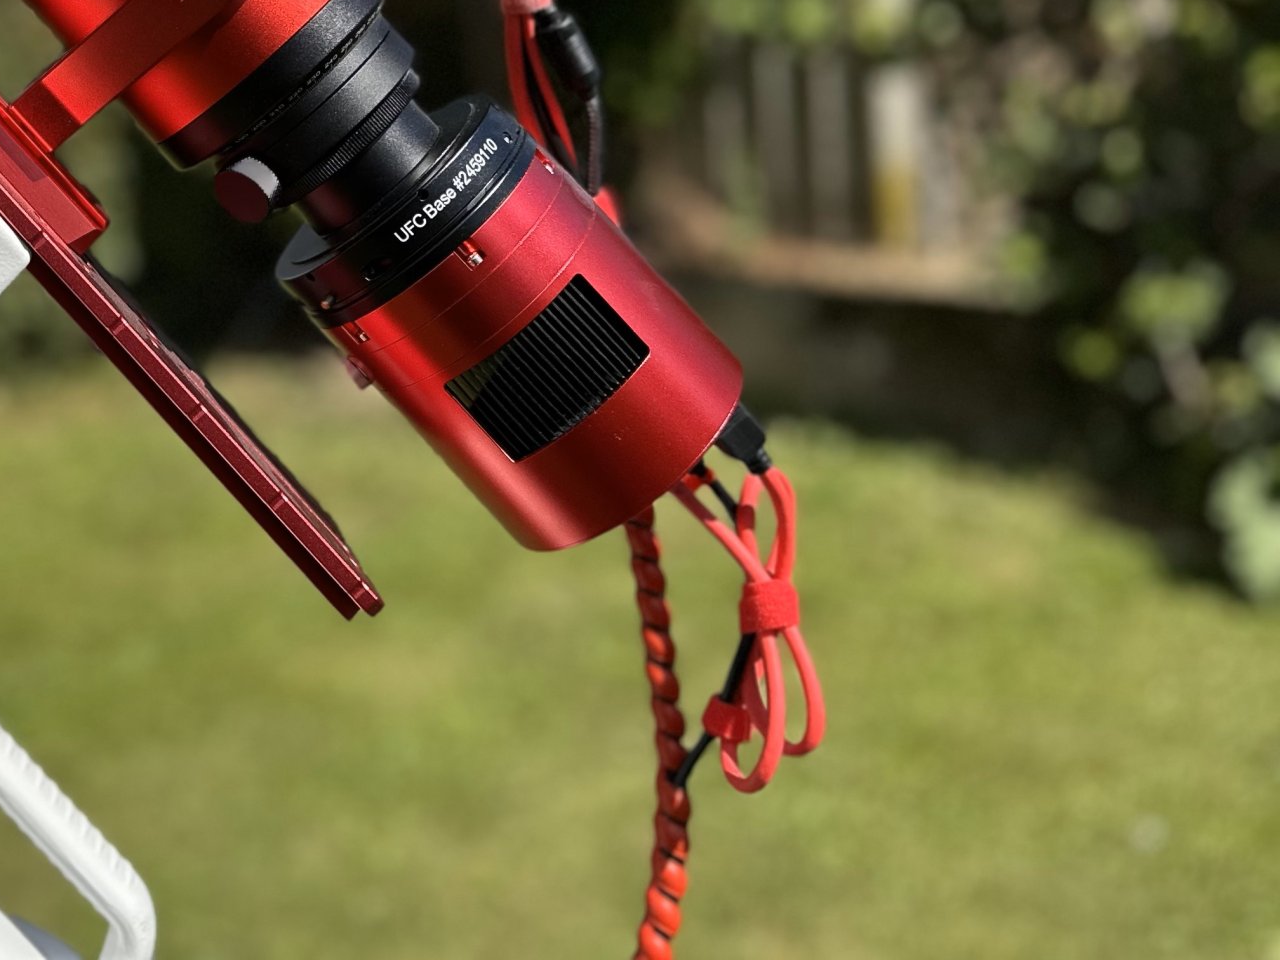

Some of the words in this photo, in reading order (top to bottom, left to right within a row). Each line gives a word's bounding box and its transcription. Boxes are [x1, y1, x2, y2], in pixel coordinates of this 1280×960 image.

[393, 213, 427, 242] UFC
[422, 187, 457, 219] Base
[452, 138, 498, 191] #2459110
